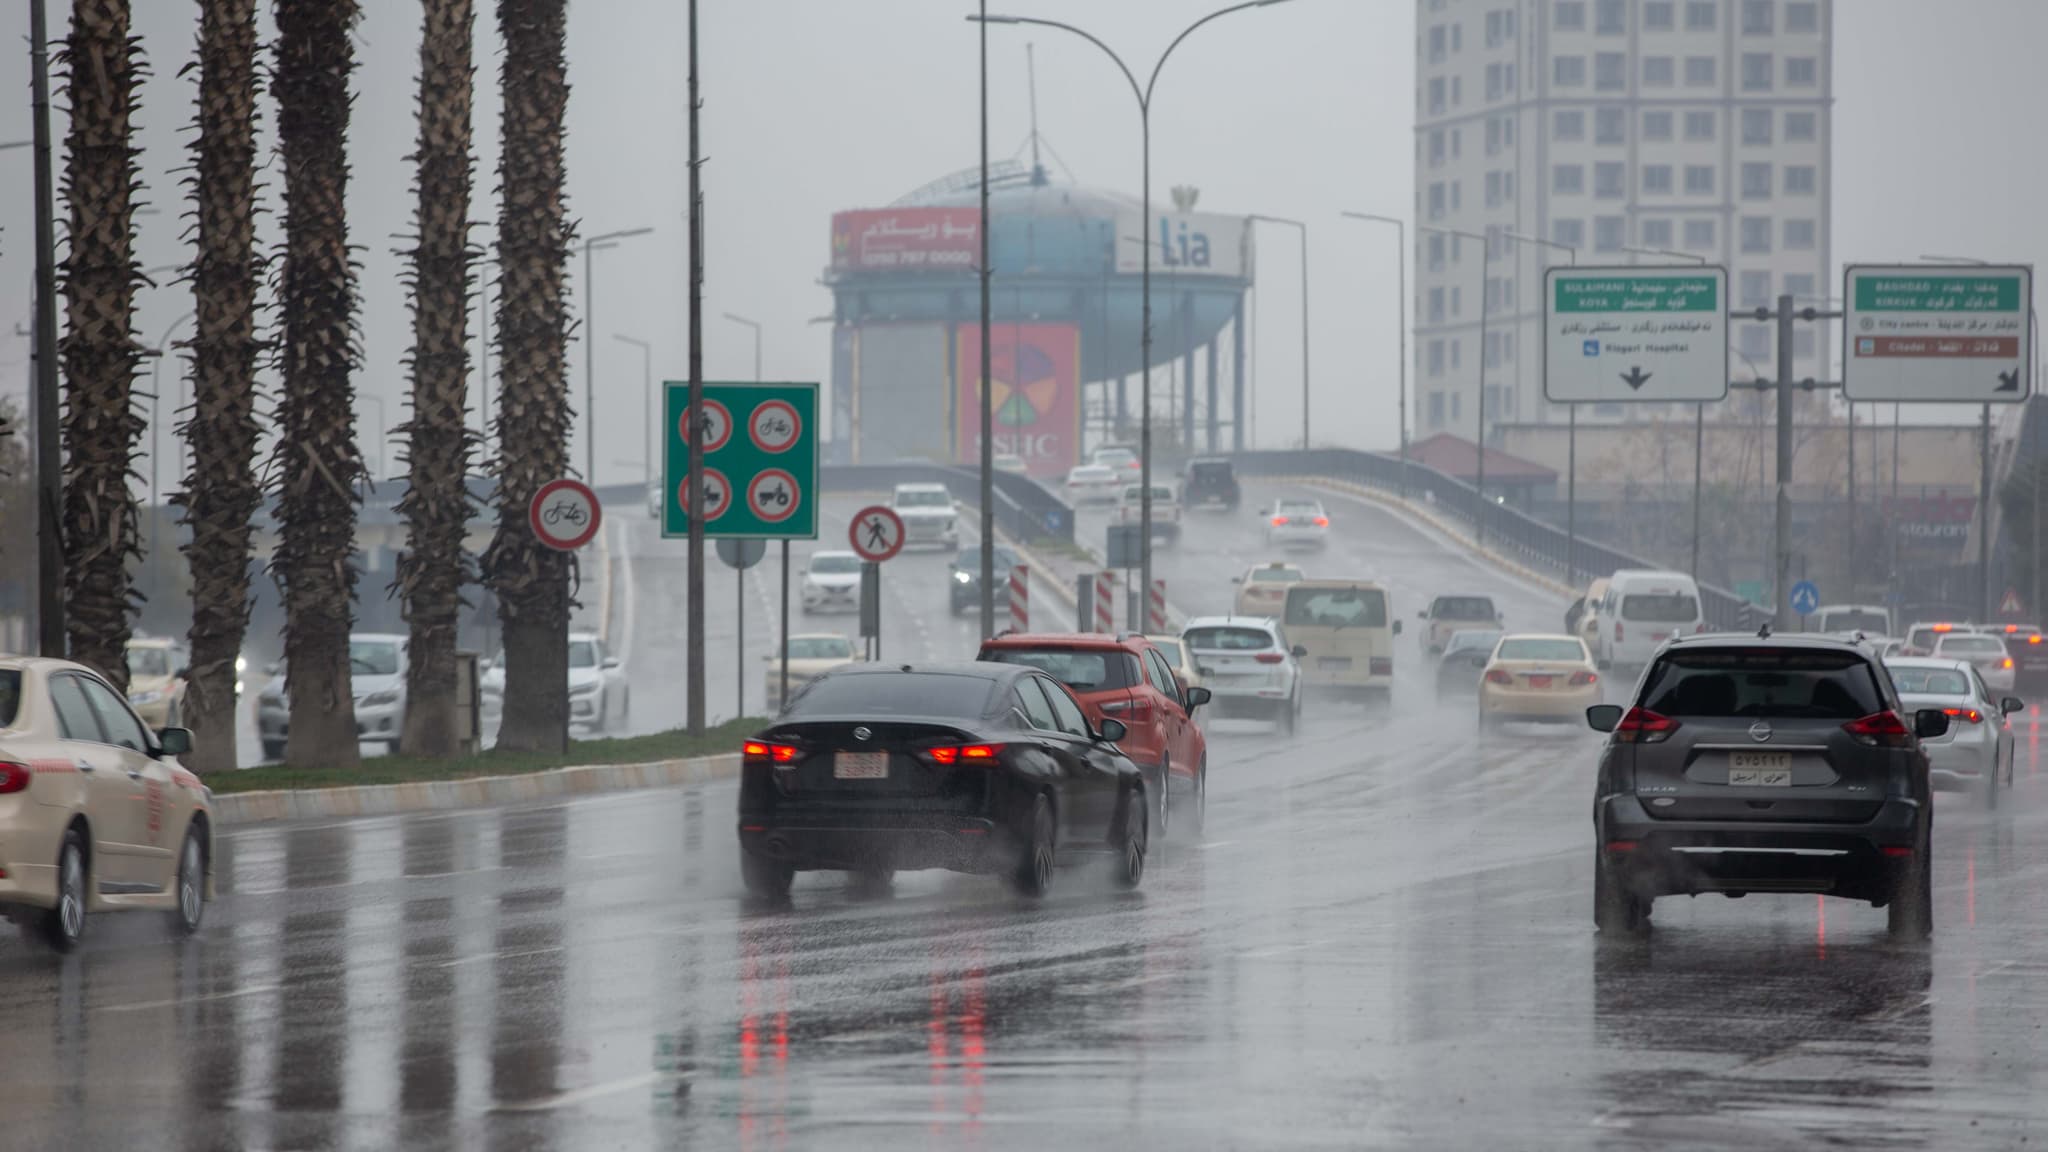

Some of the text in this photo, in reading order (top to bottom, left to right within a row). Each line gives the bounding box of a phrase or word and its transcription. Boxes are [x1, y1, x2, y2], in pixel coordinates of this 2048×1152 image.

[1160, 216, 1210, 267] Lia
[1564, 282, 1624, 293] SULAIMANI
[1875, 281, 1930, 292] BAGHDAD
[1579, 297, 1608, 308] KOYA
[1875, 297, 1916, 307] KIRKUK
[1879, 319, 1929, 330] City centre
[1645, 343, 1688, 354] Hospital
[1888, 341, 1925, 352] Citadel
[1898, 521, 1969, 537] staurant
